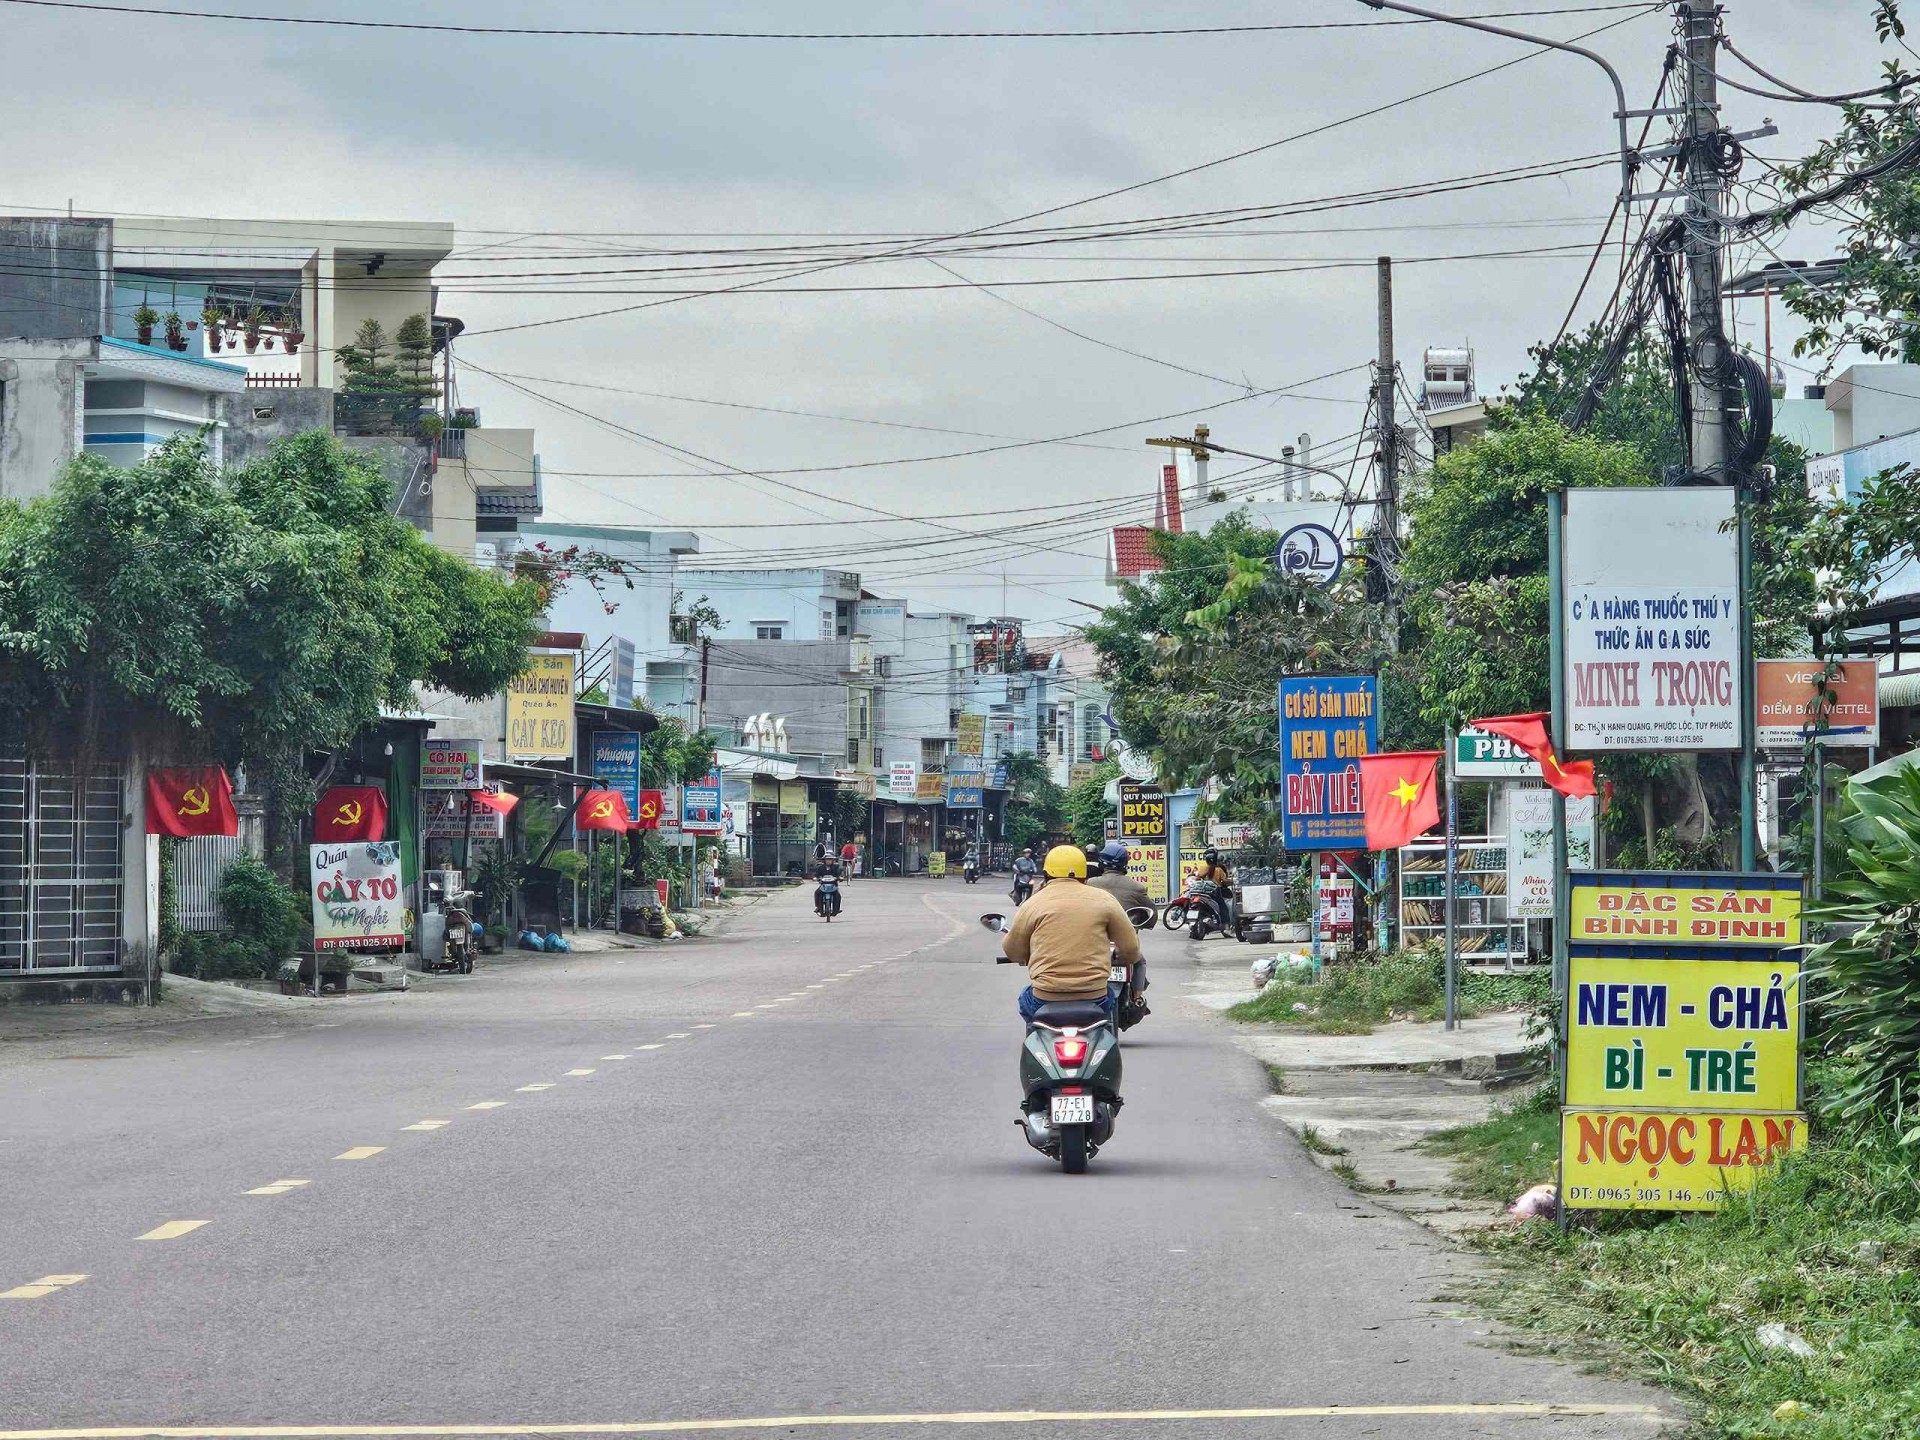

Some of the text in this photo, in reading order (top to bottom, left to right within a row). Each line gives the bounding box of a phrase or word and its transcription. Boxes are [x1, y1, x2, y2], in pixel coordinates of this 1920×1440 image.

[1603, 596, 1640, 620] HÀNG
[1644, 592, 1688, 620] THUỐC
[1692, 595, 1718, 619] THÚ
[1722, 599, 1731, 619] Y
[1595, 625, 1630, 650] THỨC
[1635, 625, 1653, 650] ĂN
[1685, 625, 1711, 650] SÚC
[1286, 681, 1372, 718] CƠ SỞ SẢN XUẤT
[1573, 660, 1733, 717] MINH TRỌNG
[1762, 699, 1792, 715] ĐIỂM
[1823, 704, 1872, 715] VIETTEL
[540, 719, 567, 749] KEO
[1291, 720, 1368, 759] NEM CHẢ
[448, 752, 468, 763] HAI
[1123, 793, 1140, 802] QUY
[1287, 762, 1325, 815] BẢY
[1123, 799, 1163, 817] BÚN
[1123, 817, 1164, 835] PHỞ
[315, 847, 348, 870] Quán
[1146, 847, 1165, 861] NÉ
[367, 873, 398, 901] TƠ
[1597, 891, 1773, 915] ĐẶC SẢN
[1583, 914, 1787, 941] BÌNH ĐỊNH
[363, 938, 380, 948] 025
[1577, 983, 1668, 1029] NEM
[1707, 971, 1790, 1032] CHẢ
[1604, 1038, 1645, 1094] BÌ
[1685, 1041, 1758, 1096] TRÉ
[1576, 1115, 1796, 1181] NGỌC LAN
[1570, 1187, 1593, 1201] ĐT:
[1597, 1187, 1632, 1201] 0965
[1636, 1187, 1661, 1202] 305
[1667, 1188, 1692, 1202] 146
